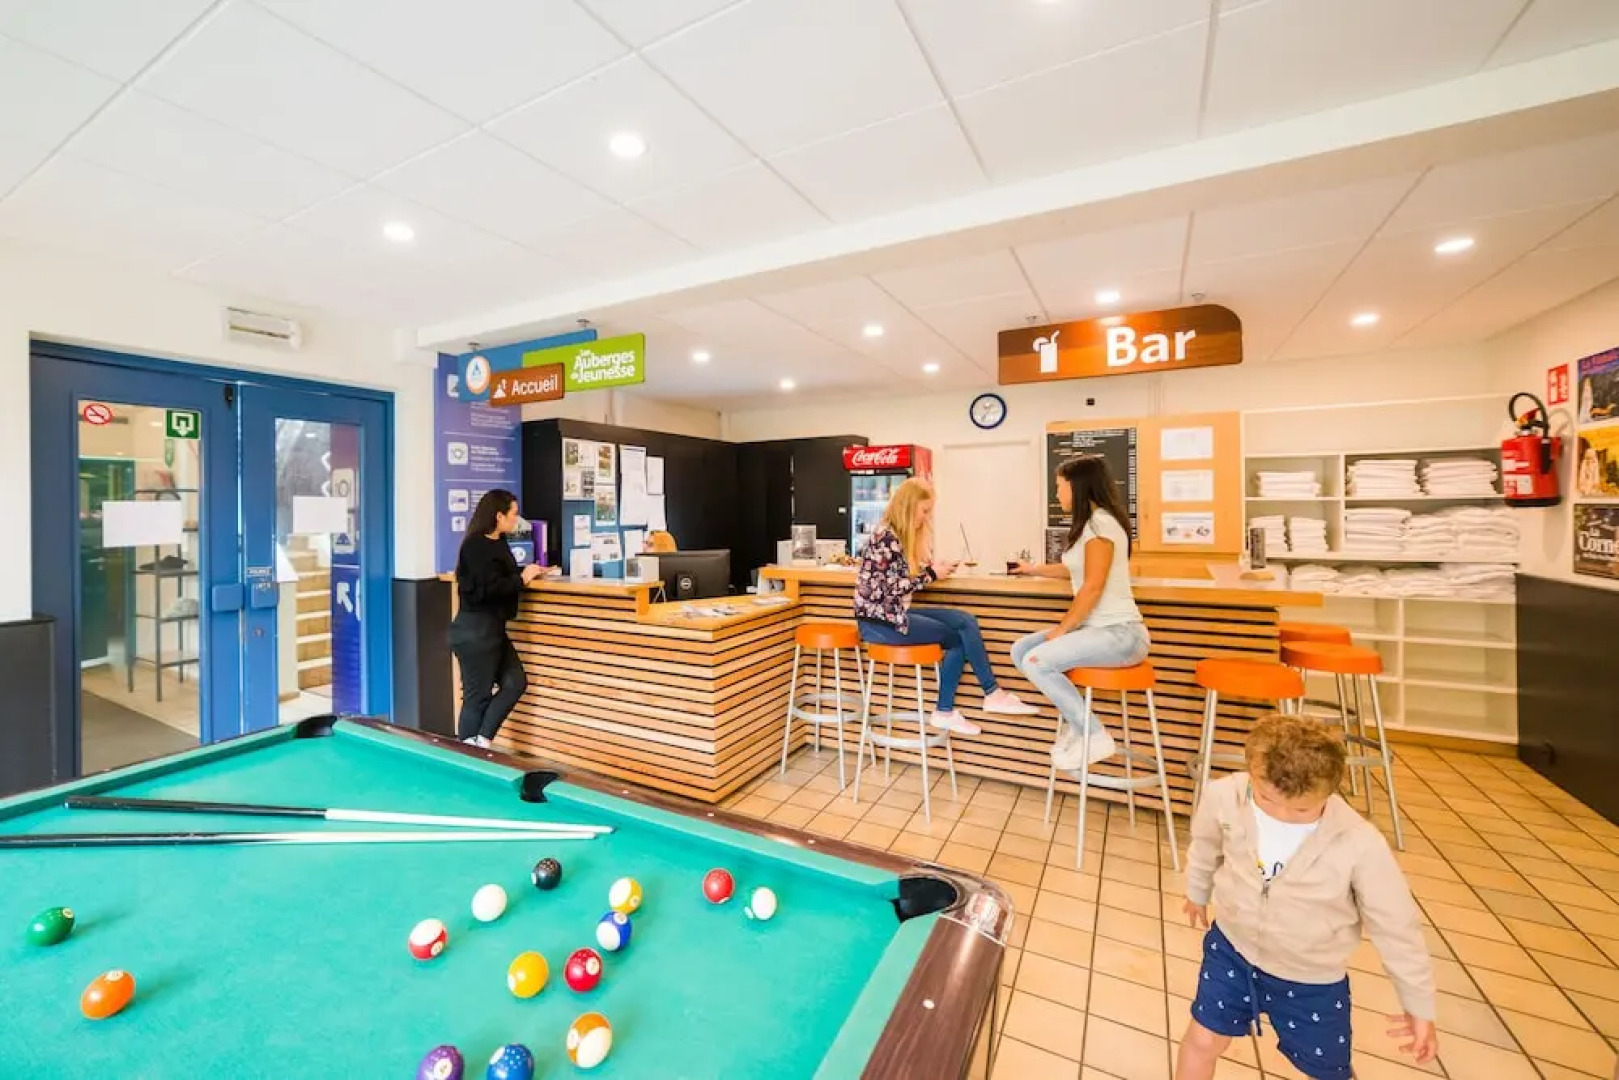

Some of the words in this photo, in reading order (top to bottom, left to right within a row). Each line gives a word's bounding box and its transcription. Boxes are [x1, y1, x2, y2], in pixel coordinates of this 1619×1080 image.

[1107, 327, 1196, 366] Bar
[573, 351, 636, 369] Auberges
[577, 365, 636, 383] Jeunesse
[511, 373, 558, 396] Accueil
